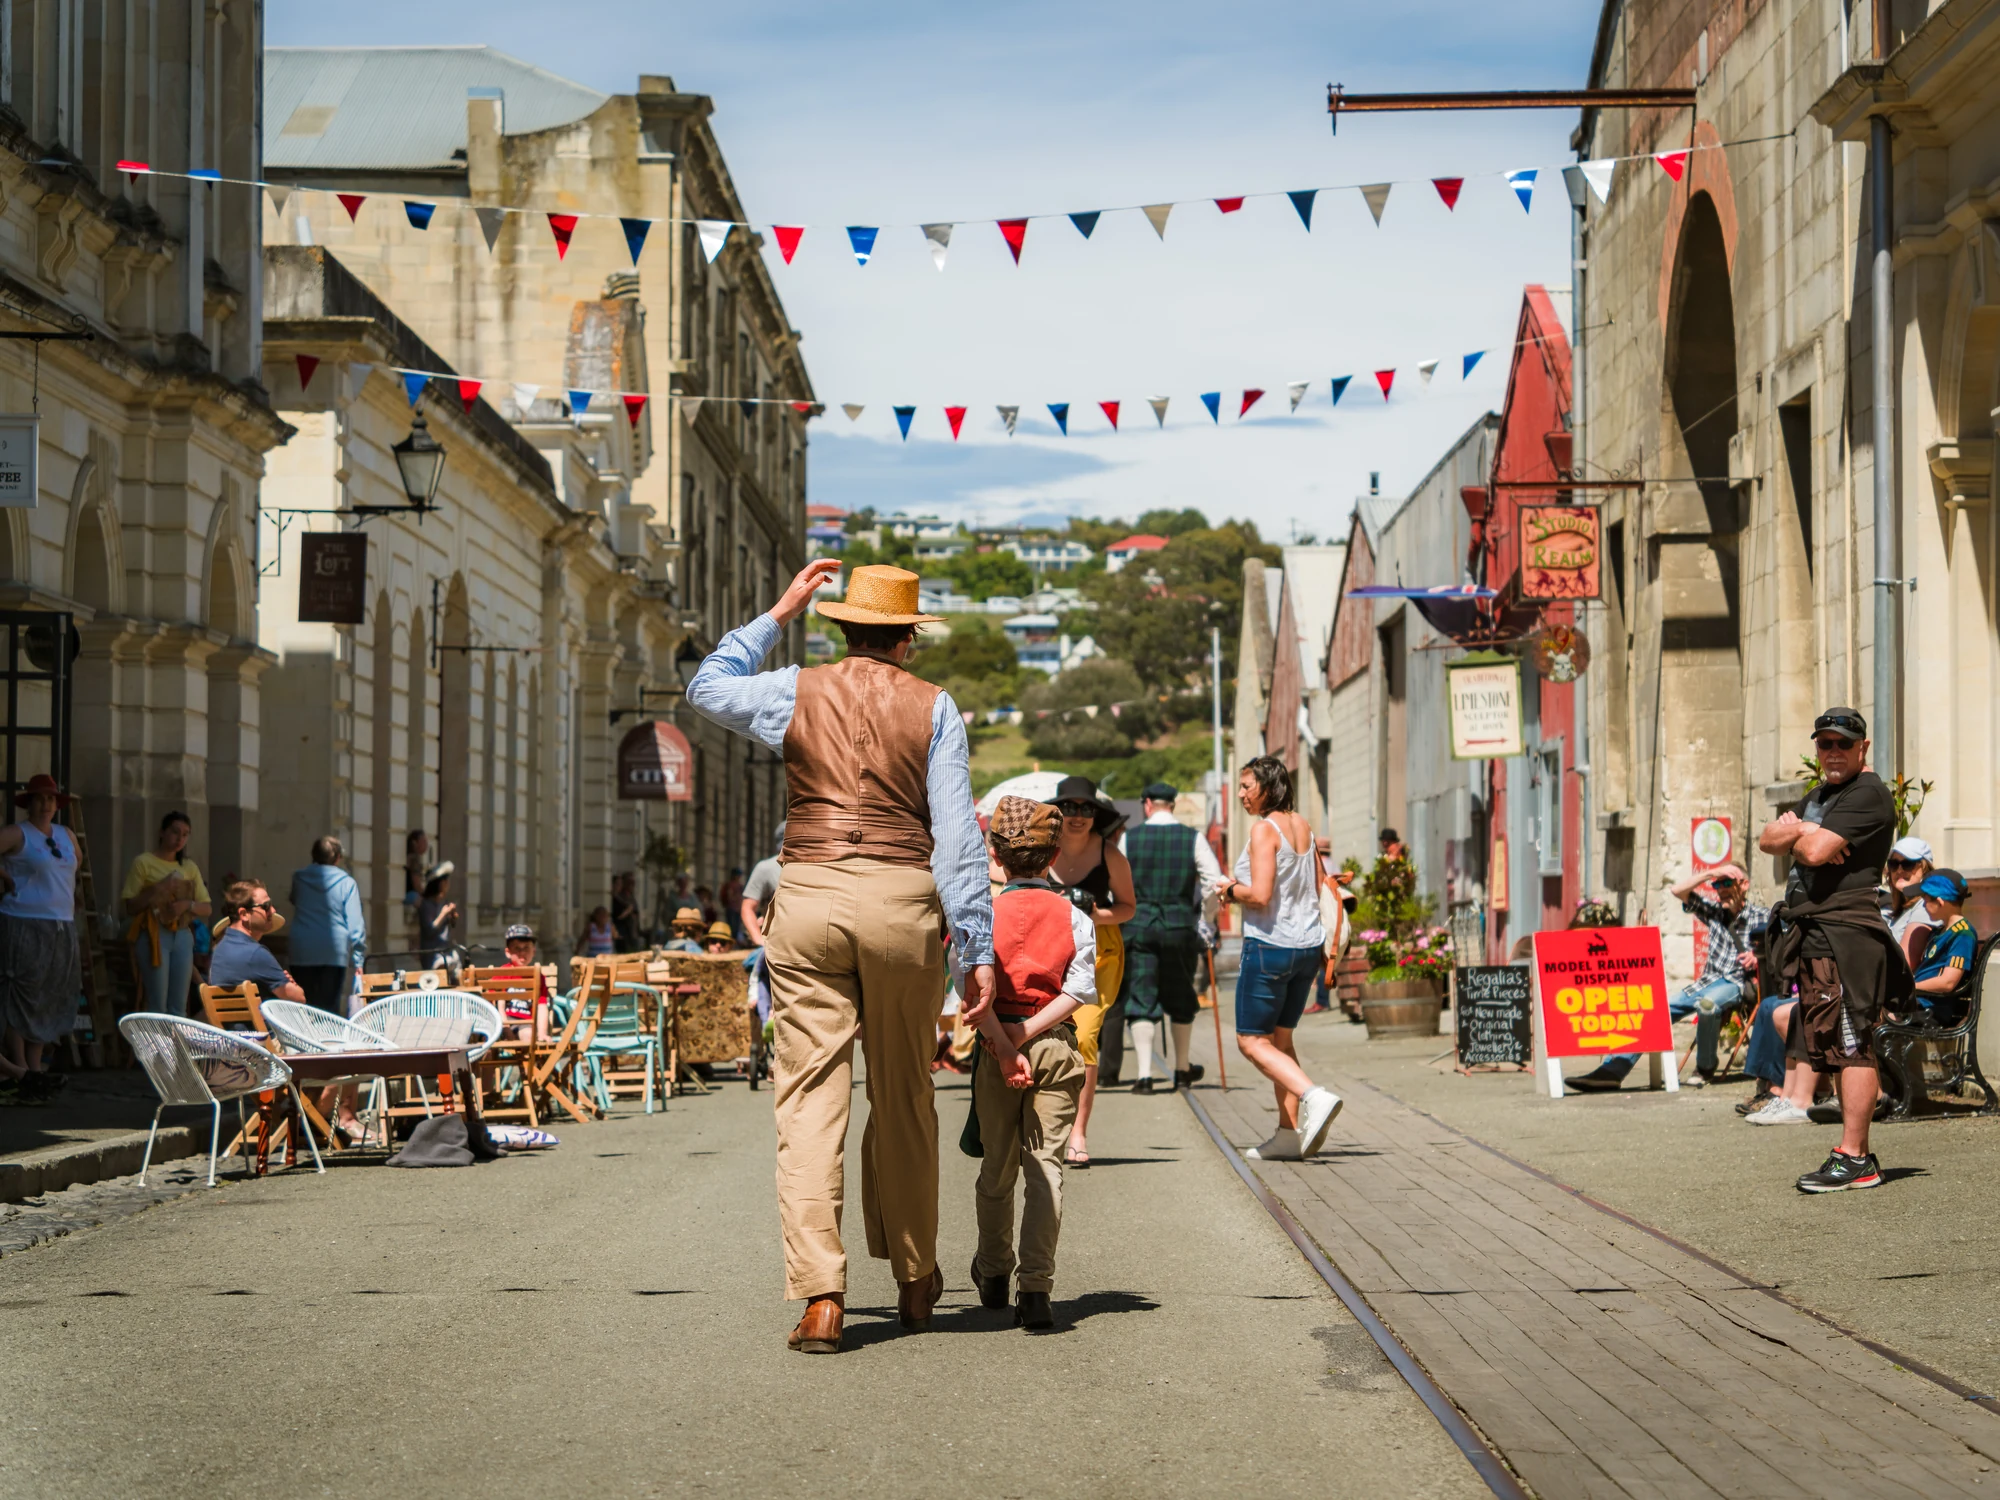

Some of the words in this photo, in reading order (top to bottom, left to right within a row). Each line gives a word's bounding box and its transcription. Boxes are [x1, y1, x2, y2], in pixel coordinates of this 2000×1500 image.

[1533, 516, 1591, 539] STUDIO
[315, 551, 352, 576] LOFT
[1534, 545, 1593, 568] REALM
[1454, 691, 1510, 711] LIMESTONE
[1464, 711, 1509, 720] SCULPTOR
[1544, 961, 1592, 973] MODEL
[1597, 957, 1656, 970] RAILWAY
[1574, 972, 1629, 985] DISPLAY
[1464, 986, 1491, 999] Time
[1492, 986, 1526, 999] Pieces
[1555, 984, 1654, 1014] OPEN
[1475, 1006, 1494, 1019] New
[1496, 1005, 1523, 1019] made
[1470, 1018, 1514, 1031] Original
[1568, 1012, 1644, 1033] TODAY
[1469, 1041, 1514, 1054] Jewellery
[1464, 1051, 1521, 1062] Accessories
